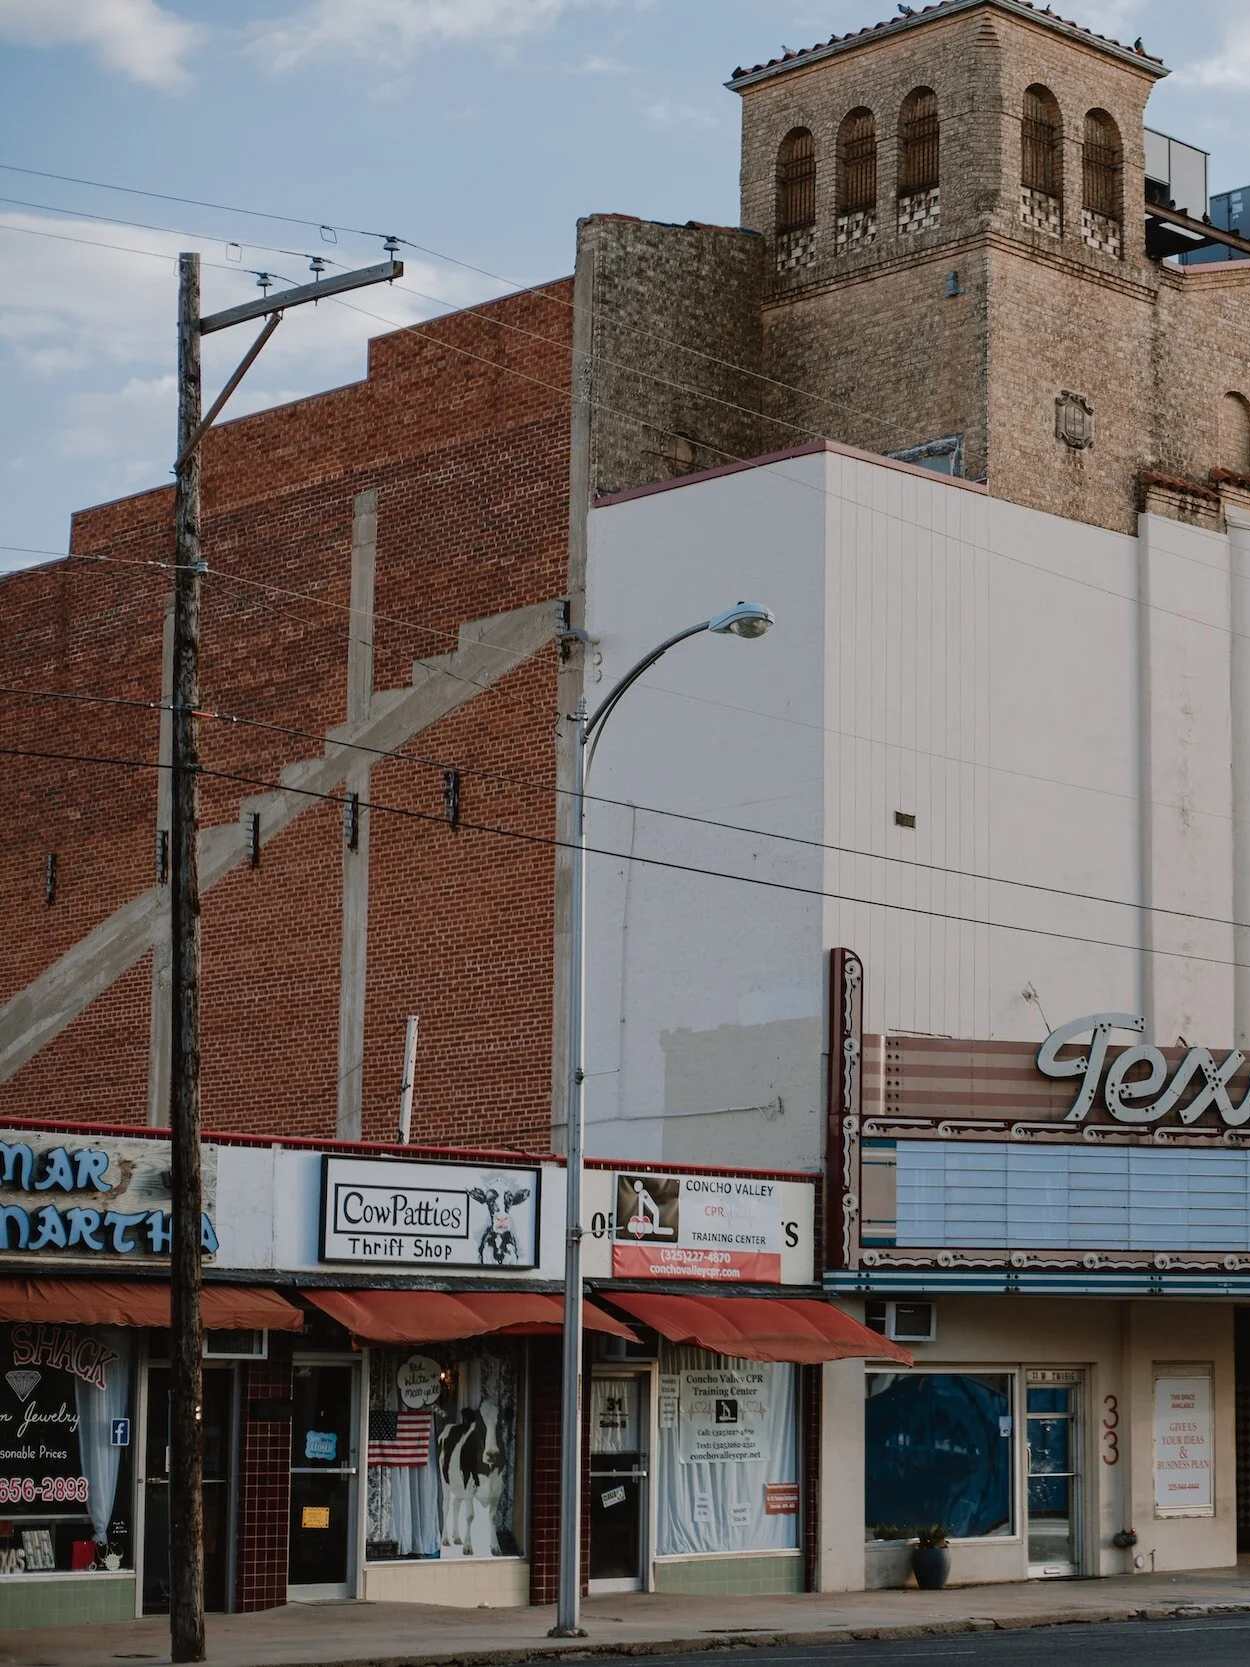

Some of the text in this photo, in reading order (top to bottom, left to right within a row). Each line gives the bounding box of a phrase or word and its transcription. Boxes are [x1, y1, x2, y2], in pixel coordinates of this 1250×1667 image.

[686, 1180, 774, 1197] CONCHO VALLEY
[704, 1205, 725, 1217] CPR
[692, 1232, 766, 1245] TRAINING CENTER
[348, 1238, 452, 1261] Thrift Shop
[660, 1250, 731, 1264] (325)227-4870
[650, 1264, 740, 1278] conchovalleycpr.com
[12, 1324, 118, 1391] SHACK
[686, 1374, 718, 1384] Concho
[746, 1374, 764, 1384] CPR
[692, 1386, 758, 1397] Training Center
[606, 1398, 622, 1412] 31
[17, 1400, 80, 1438] Jewelry
[600, 1420, 619, 1429] Suite
[1169, 1422, 1198, 1432] GIVE US
[696, 1441, 712, 1449] Text:
[1161, 1435, 1205, 1446] YOUR IDEAS
[39, 1445, 68, 1459] Prices
[690, 1451, 761, 1461] conchovalleycpr.net
[1178, 1446, 1188, 1459] &
[1157, 1459, 1210, 1470] BUSINESS PLAN
